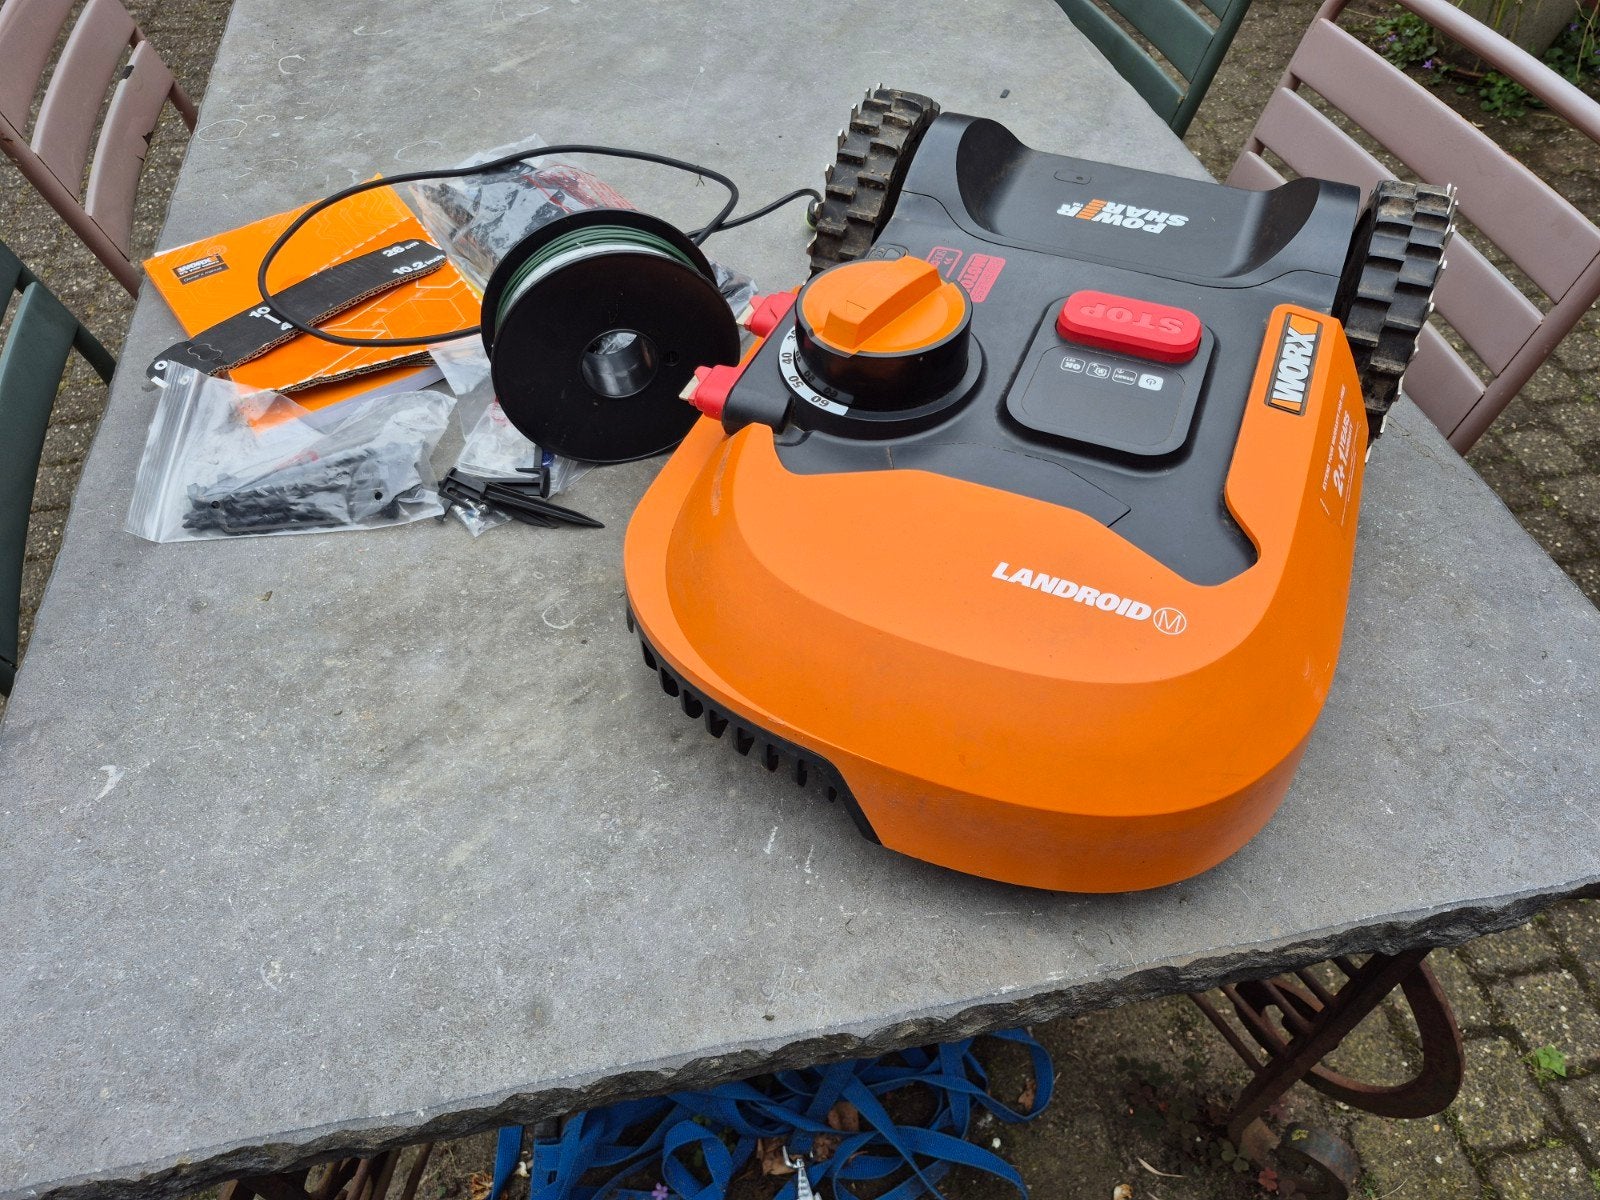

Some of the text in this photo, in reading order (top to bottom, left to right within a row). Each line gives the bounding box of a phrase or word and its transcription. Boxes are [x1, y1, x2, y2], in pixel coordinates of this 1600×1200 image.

[1057, 199, 1167, 234] POWER
[392, 261, 428, 275] 10.2
[249, 306, 271, 318] 10
[1080, 303, 1184, 334] STOP
[781, 352, 793, 365] 40
[1272, 326, 1316, 403] WORX
[788, 375, 805, 389] 50
[810, 395, 831, 407] 60
[991, 561, 1152, 621] LANDROID
